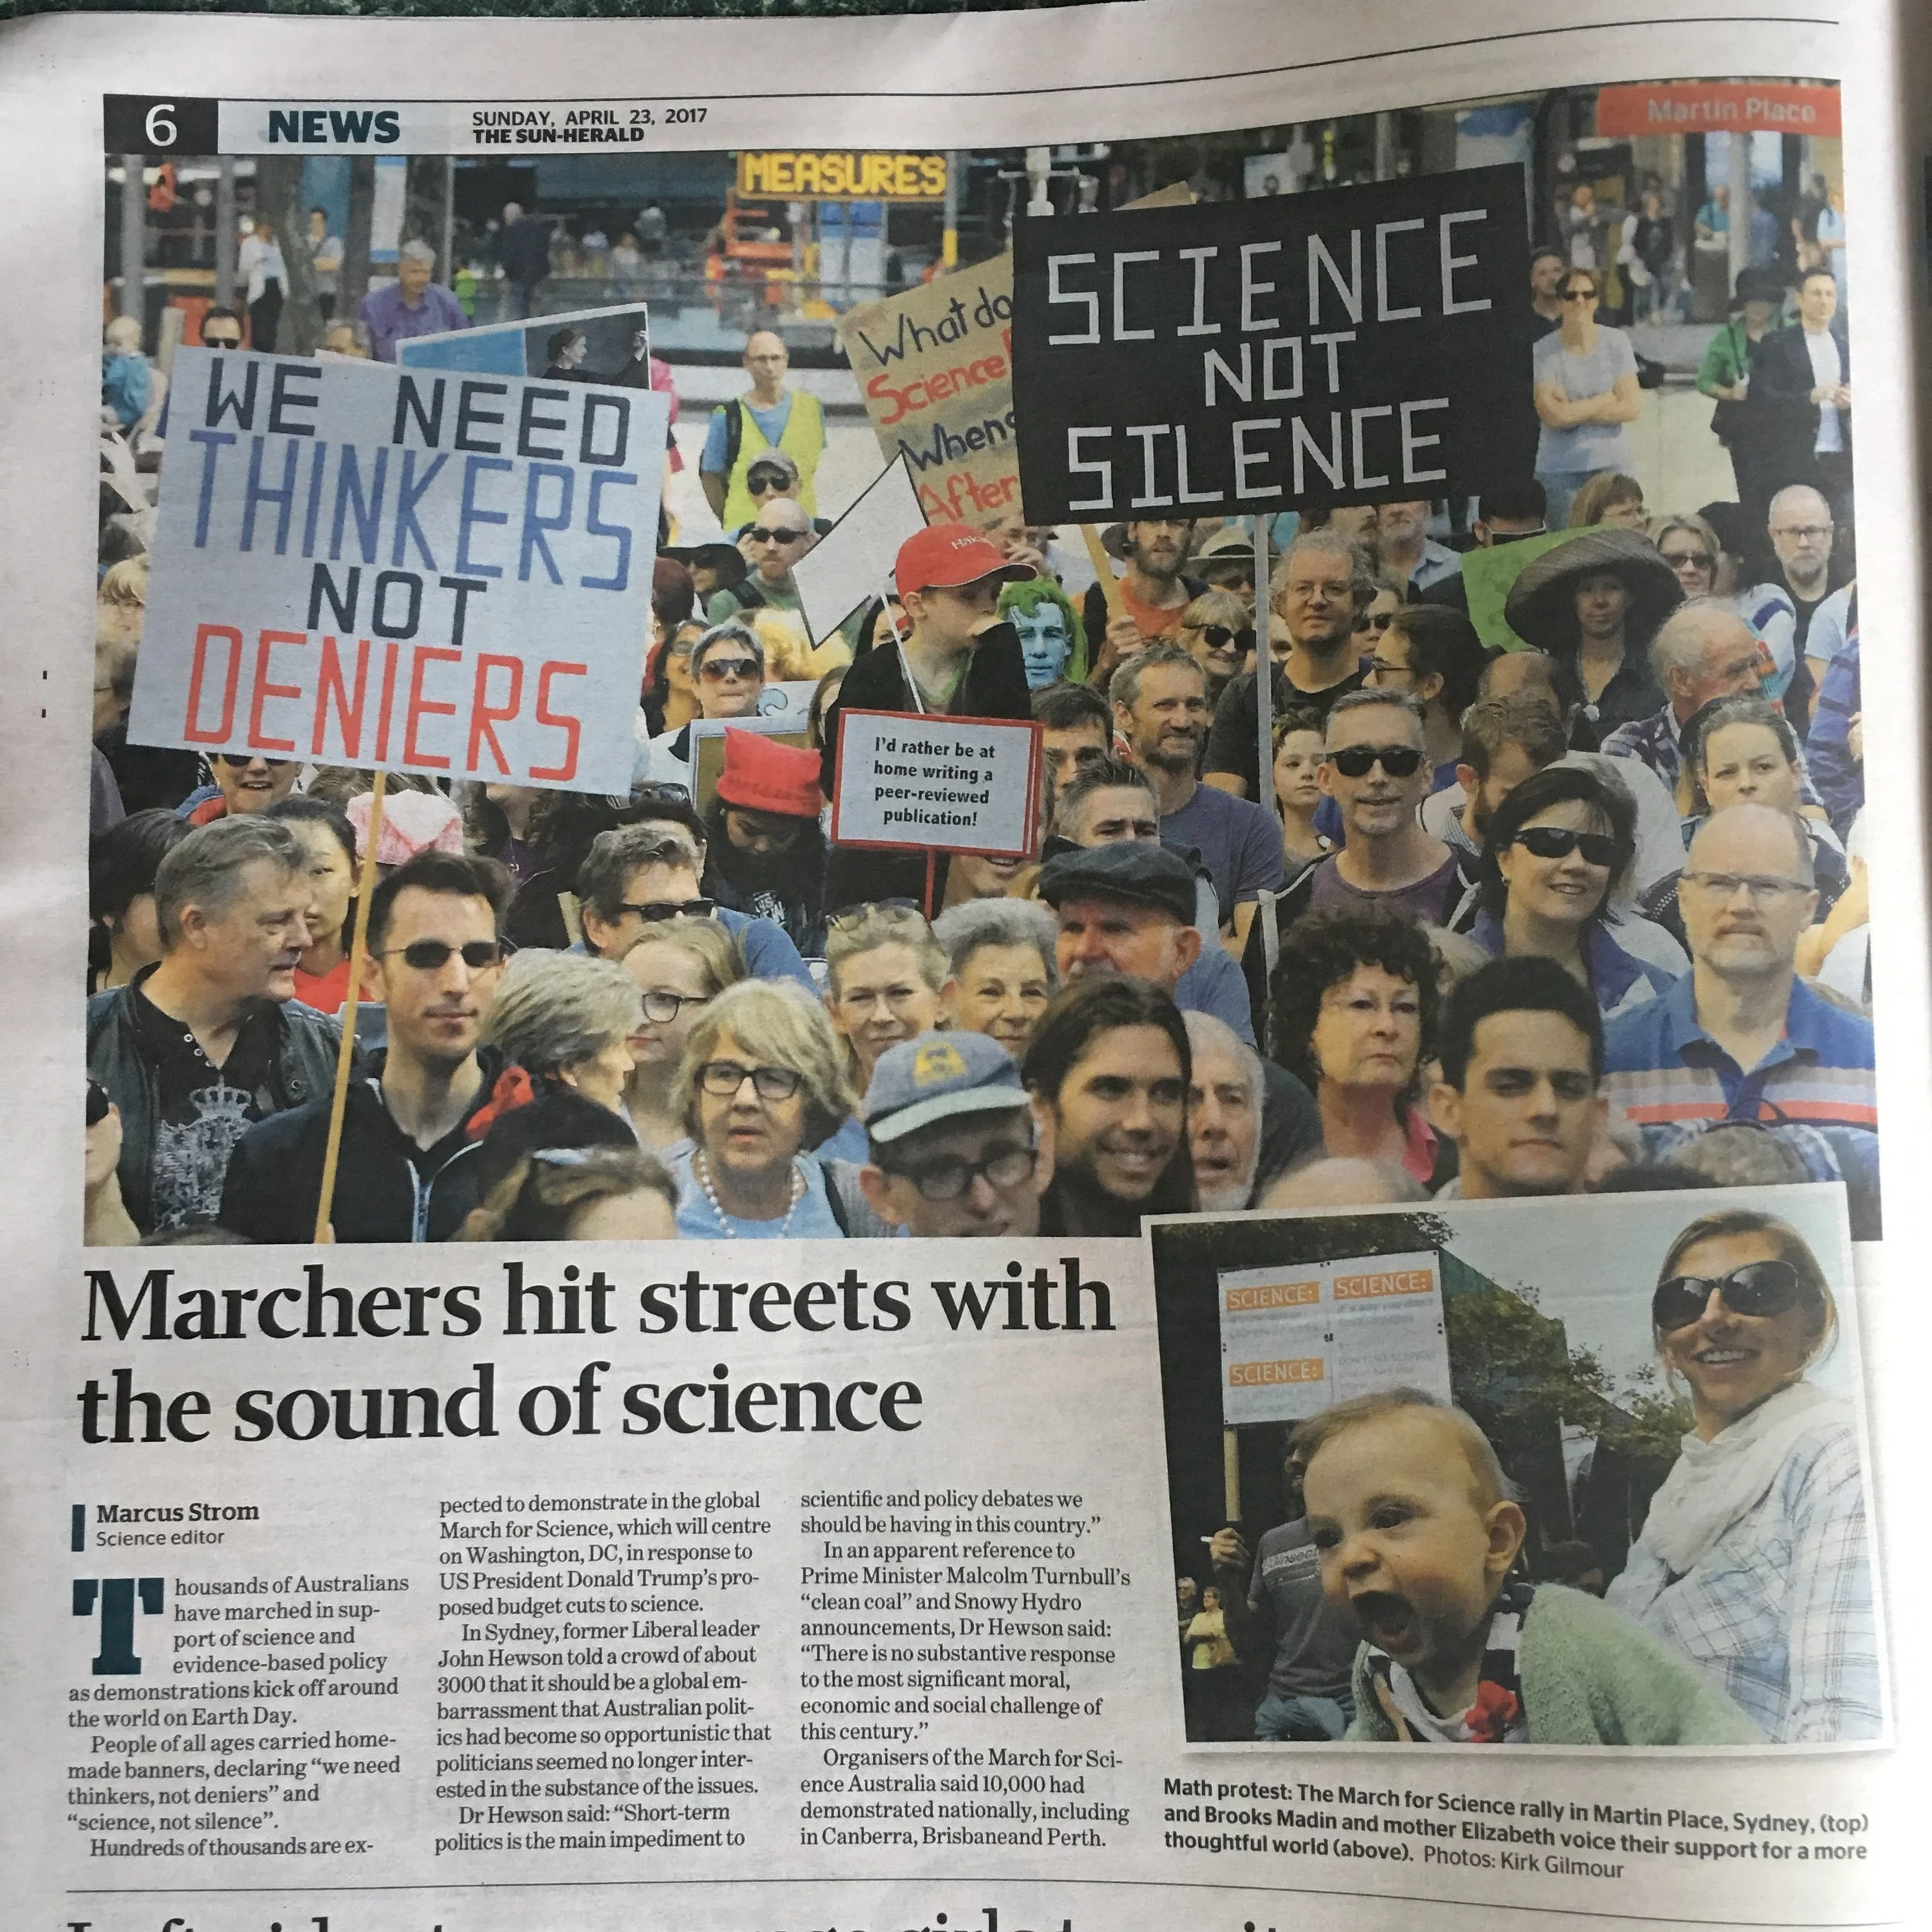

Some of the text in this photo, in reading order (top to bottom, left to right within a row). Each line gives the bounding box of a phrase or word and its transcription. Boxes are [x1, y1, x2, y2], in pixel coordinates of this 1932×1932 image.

[472, 107, 708, 129] SUNDAY, APRIL 23, 2017
[1648, 97, 1817, 123] Martin Place
[145, 104, 179, 148] 6
[268, 109, 401, 145] NEWS
[472, 127, 645, 145] THE SUN-HERALD
[743, 153, 947, 196] MEASURES
[1047, 209, 1492, 345] SCIENCE
[858, 296, 968, 366] What
[974, 287, 1013, 328] do
[1202, 331, 1357, 406] NOT
[866, 355, 1008, 425] Science
[205, 357, 631, 468] WE NEED
[1066, 396, 1450, 512] SILENCE
[918, 471, 1019, 522] After
[189, 429, 639, 592] THINKERS
[307, 563, 488, 647] NOT
[182, 622, 589, 782] DENIERS
[874, 736, 995, 758] I'd rather be at
[873, 760, 993, 784] home writing a
[874, 785, 990, 804] peer-reviewed
[883, 808, 978, 827] publication!
[1227, 1287, 1314, 1309] SCIENCE:
[1336, 1272, 1427, 1298] SCIENCE:
[80, 1257, 1117, 1342] Marchers hit streets with
[1231, 1362, 1318, 1385] SCIENCE:
[76, 1360, 923, 1444] the sound of science
[97, 1502, 260, 1524] Marcus Strom
[439, 1490, 761, 1519] pected to demonstrate in the global
[96, 1529, 226, 1547] Science editor
[439, 1516, 771, 1539] March for Science, which will centre
[439, 1543, 753, 1568] on Washington, DC, in response to
[175, 1573, 410, 1597] housands of Australians
[439, 1568, 760, 1590] US President Donald Trump's pro-
[801, 1566, 1131, 1586] Prime Minister Malcolm Turnbull's
[174, 1600, 381, 1622] have marched in sup-
[172, 1625, 355, 1653] port of science and
[172, 1651, 389, 1675] evidence-based policy
[68, 1675, 400, 1702] as demonstrations kick off around
[68, 1706, 298, 1729] the world on Earth Day.
[823, 1747, 1123, 1771] Organisers of the March for Sci-
[800, 1774, 1086, 1797] ence Australia said 10,000 had
[800, 1799, 1131, 1826] demonstrated nationally, including
[1164, 1777, 1869, 1836] Math protest: The March for Science rally in Martin Place, Sydney, (top)
[800, 1827, 818, 1845] in
[821, 1826, 918, 1849] Canberra,
[1046, 1827, 1107, 1847] Perth.
[1164, 1804, 1867, 1861] and Brooks Madin and mother Elizabeth voice their support for a more
[1164, 1830, 1624, 1879] thoughtful world (above). Photos: Kirk Gilmour
